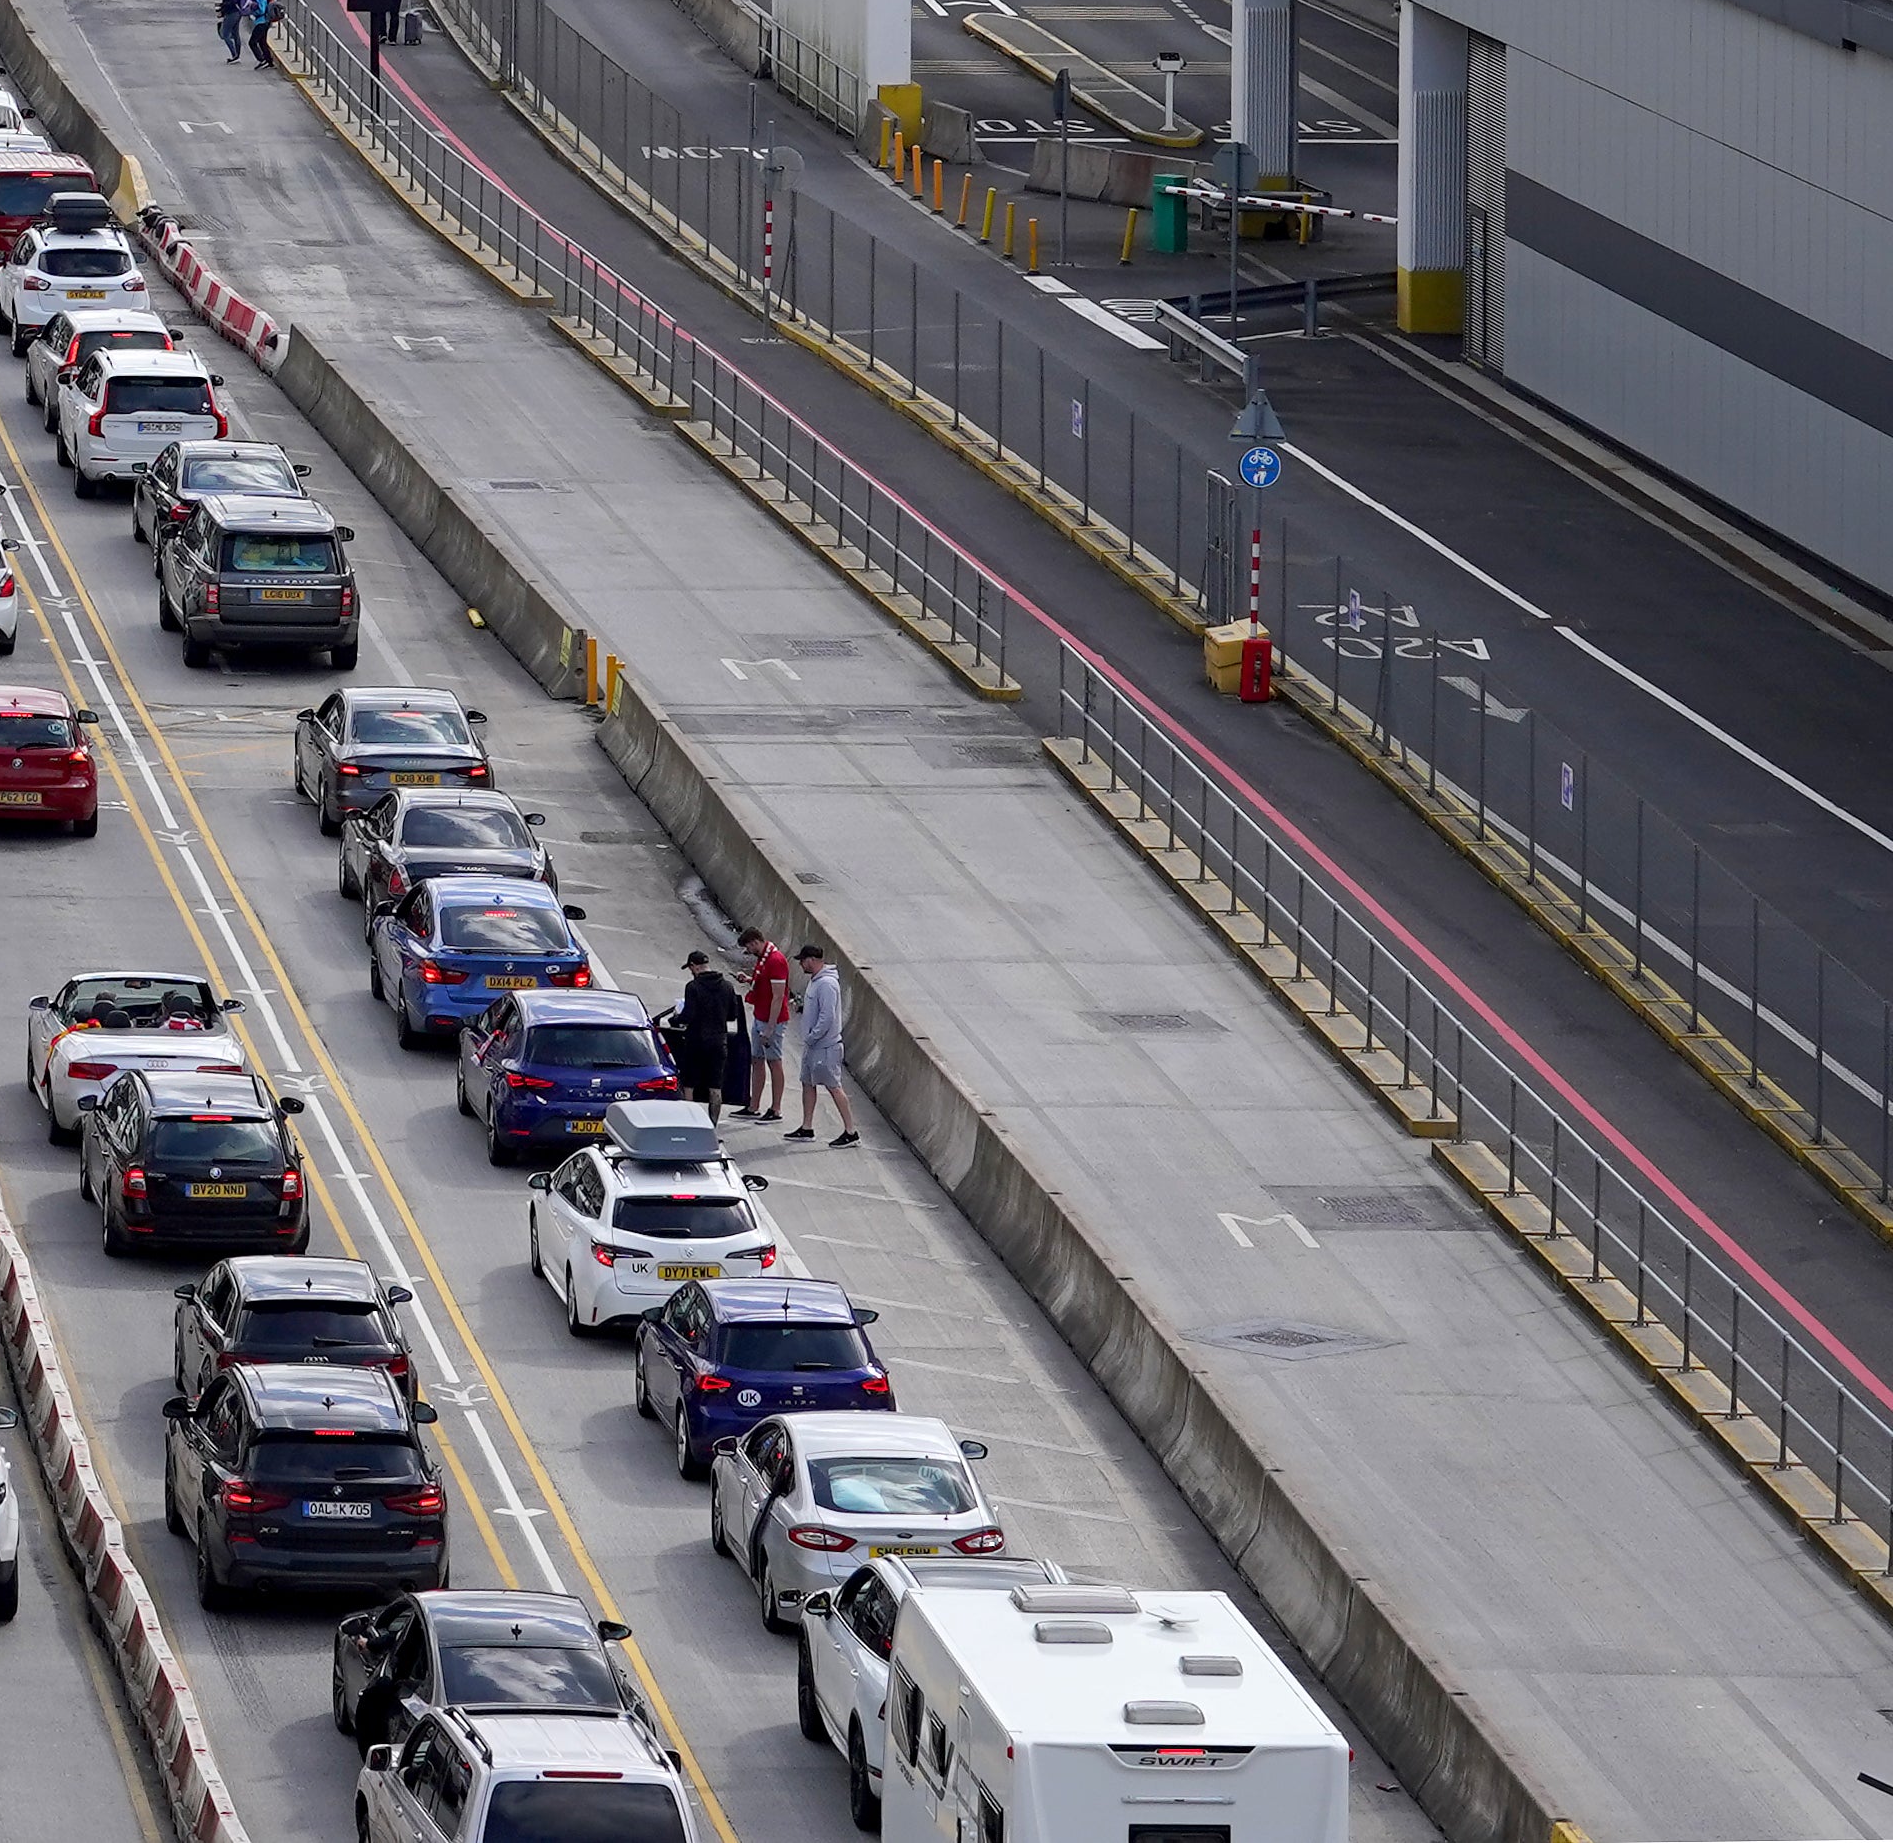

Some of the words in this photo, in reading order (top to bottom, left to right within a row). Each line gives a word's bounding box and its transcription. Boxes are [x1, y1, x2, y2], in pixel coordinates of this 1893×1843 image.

[488, 977, 512, 987] DX14
[513, 977, 534, 987] PLZ
[616, 1091, 630, 1099] UK
[192, 1184, 221, 1196] BV20
[222, 1184, 245, 1196] NND
[632, 1263, 648, 1273] UK
[664, 1266, 690, 1278] DY71
[691, 1266, 715, 1278] EWL
[739, 1392, 757, 1404] UK
[920, 1467, 939, 1479] UK
[309, 1502, 332, 1516] OAL
[338, 1502, 347, 1516] K
[348, 1502, 370, 1516] 705
[1138, 1757, 1224, 1767] SWIFT
